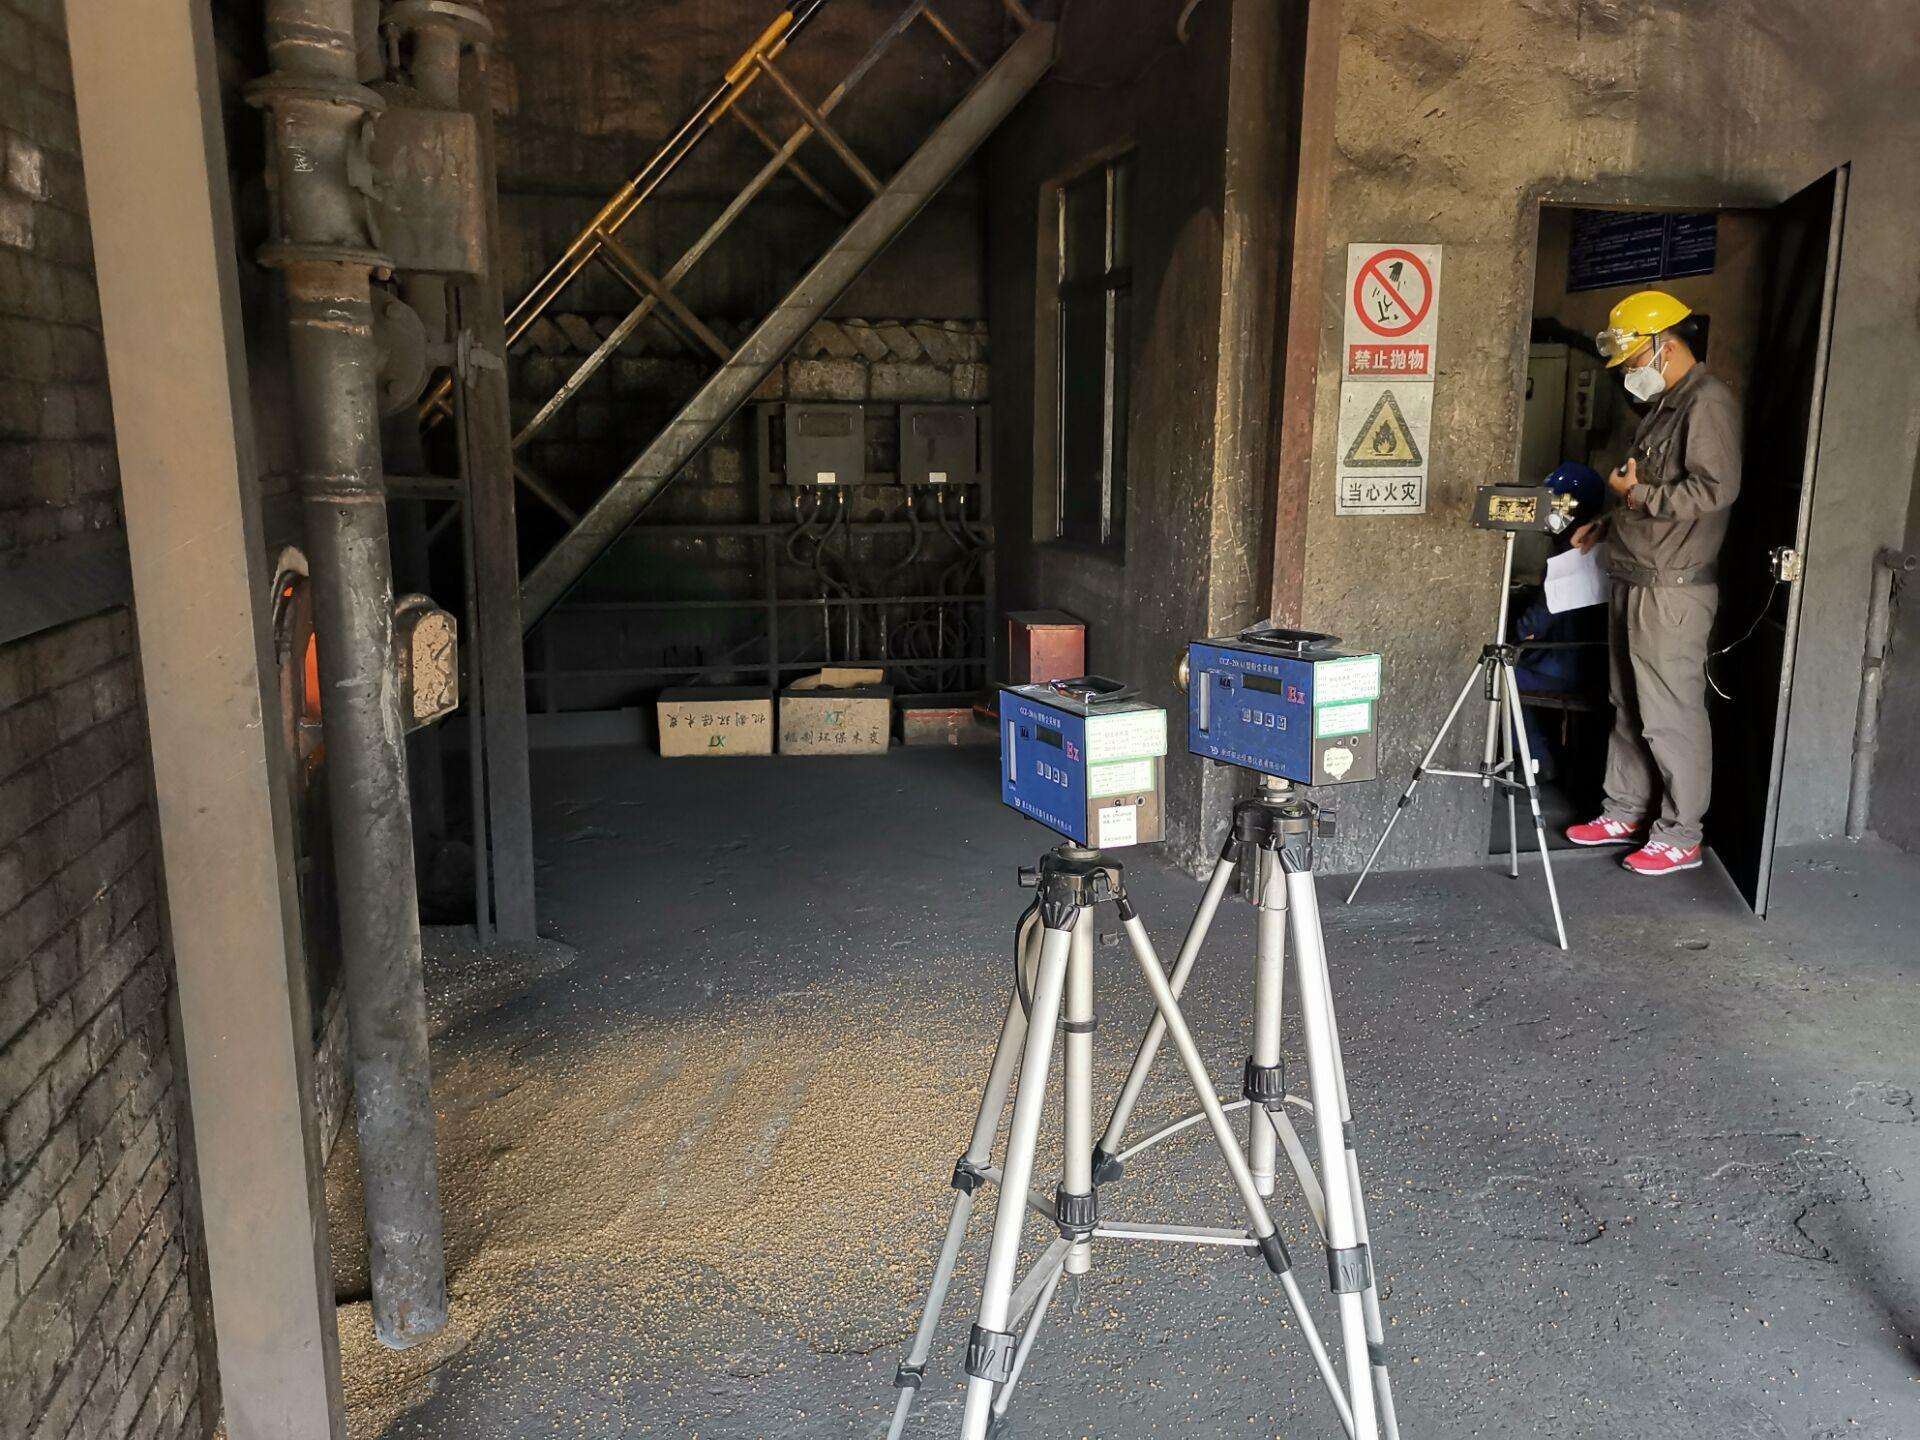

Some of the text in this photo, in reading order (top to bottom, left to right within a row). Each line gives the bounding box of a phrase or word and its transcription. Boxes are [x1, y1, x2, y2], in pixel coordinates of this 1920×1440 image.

[1354, 349, 1425, 370] 禁止抛物
[1348, 481, 1416, 502] 当心火灾
[1287, 686, 1306, 705] Ex
